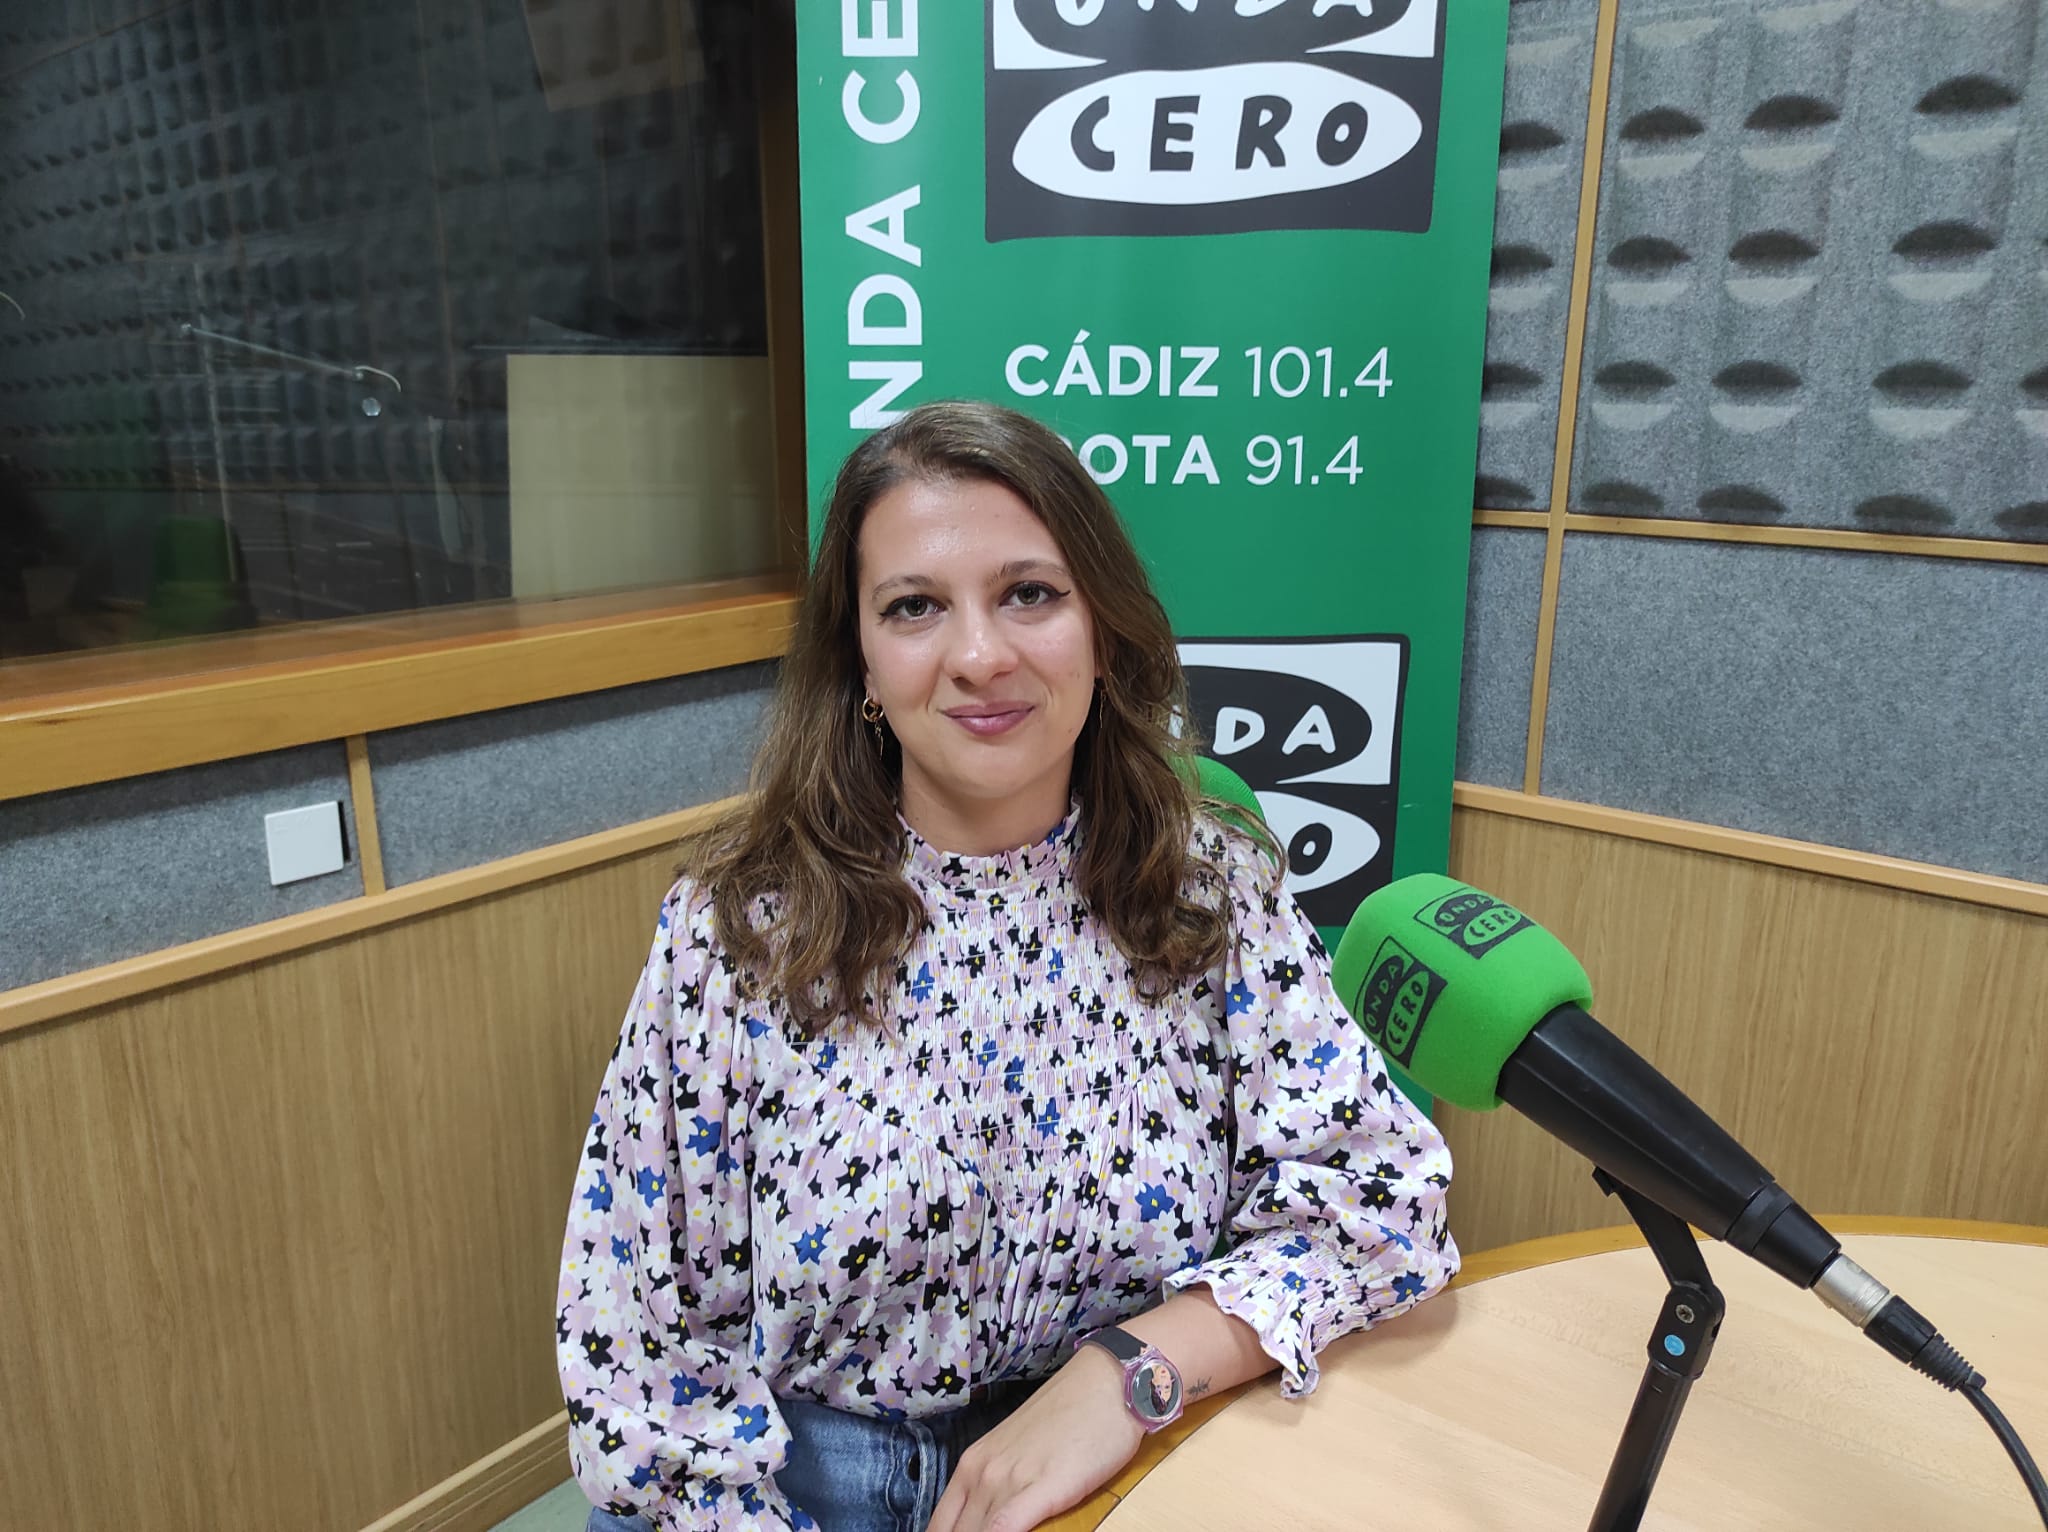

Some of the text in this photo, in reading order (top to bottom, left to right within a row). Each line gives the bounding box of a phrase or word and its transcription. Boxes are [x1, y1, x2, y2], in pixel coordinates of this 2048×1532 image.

[1070, 94, 1369, 173] CERO
[841, 0, 923, 429] NDA CE
[1004, 329, 1393, 398] CÁDIZ 101.4
[1060, 433, 1364, 486] OTA 91.4
[1168, 704, 1336, 756] DA
[1469, 909, 1516, 938] CERO
[1366, 964, 1399, 1028] ONDA
[1388, 980, 1424, 1045] CERO
